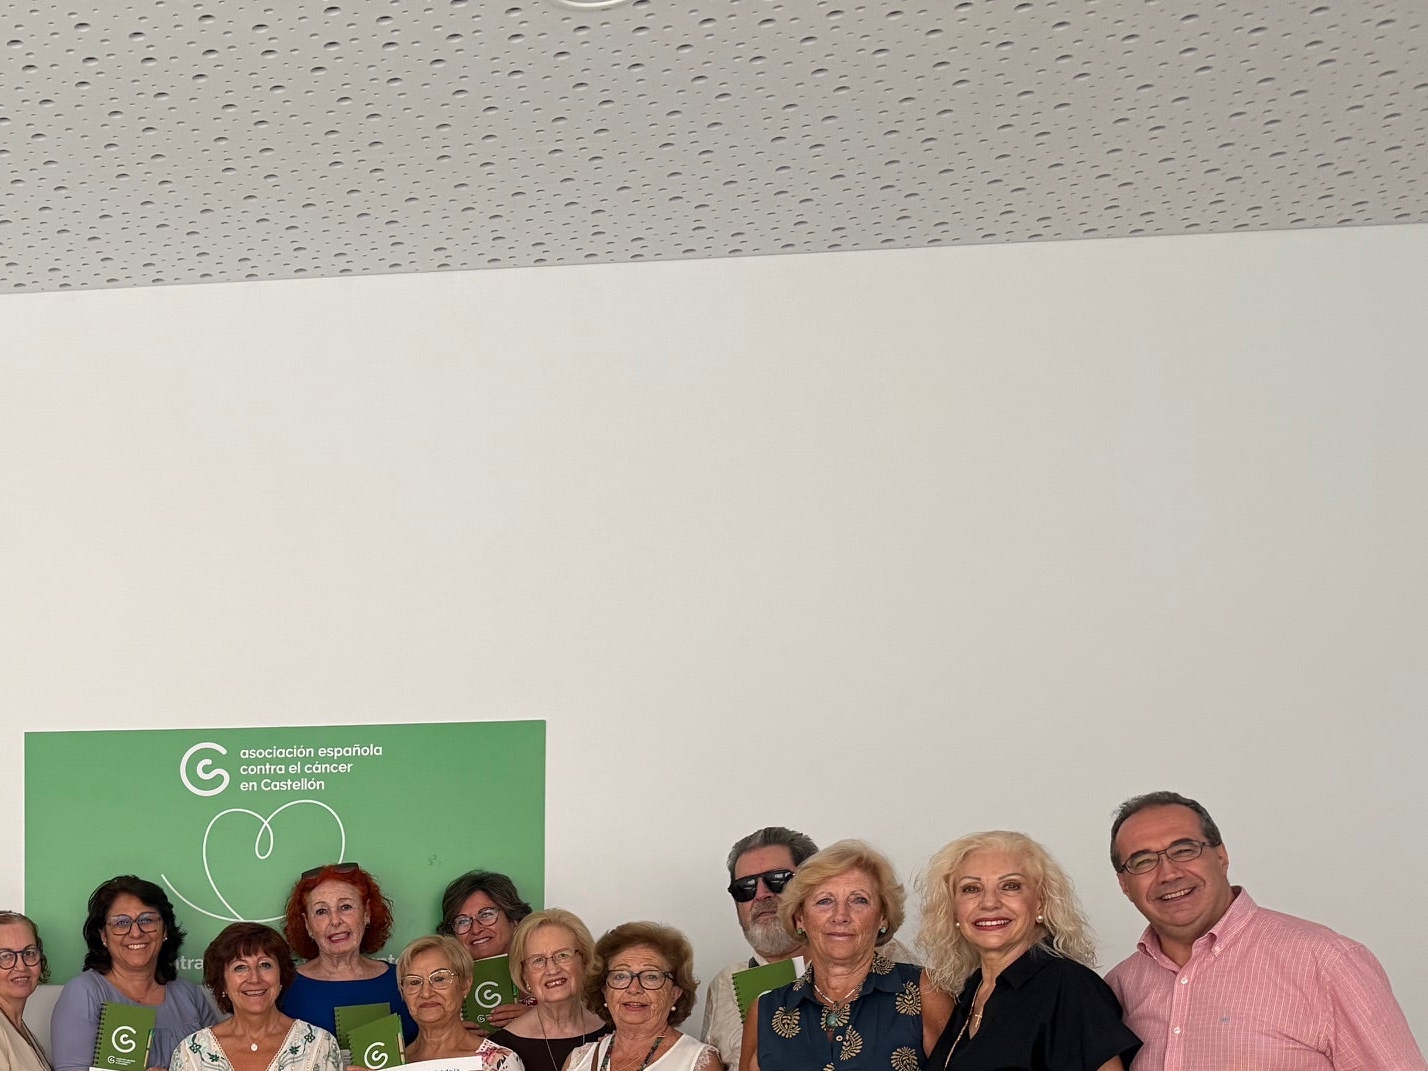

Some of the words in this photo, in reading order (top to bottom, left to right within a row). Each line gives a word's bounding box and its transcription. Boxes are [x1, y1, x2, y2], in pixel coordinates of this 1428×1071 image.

[240, 746, 314, 758] asociación
[318, 744, 383, 759] española
[240, 763, 285, 774] contra
[289, 762, 301, 773] el
[305, 761, 353, 773] cáncer
[240, 782, 257, 791] en
[261, 778, 324, 790] Castellón
